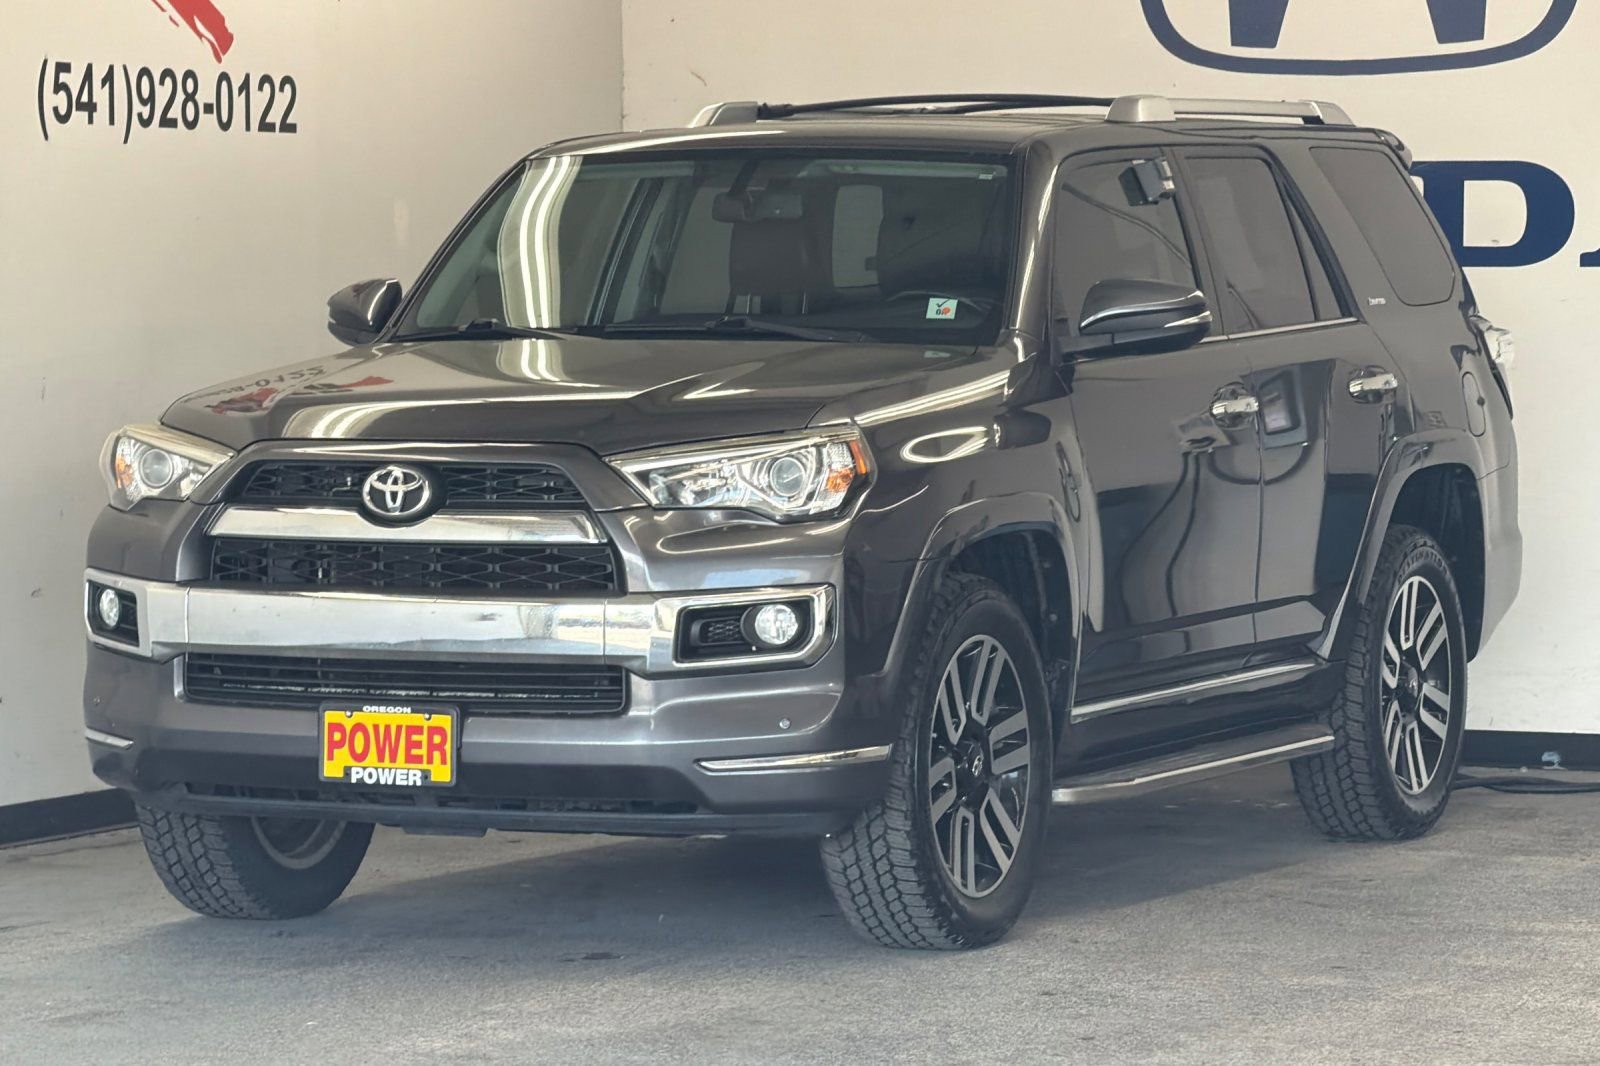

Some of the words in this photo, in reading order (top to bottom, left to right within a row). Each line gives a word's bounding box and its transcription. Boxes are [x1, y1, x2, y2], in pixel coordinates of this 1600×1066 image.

[38, 57, 298, 145] (541)928-0122
[362, 705, 412, 714] OREGON
[326, 722, 448, 766] POWER
[350, 766, 422, 786] POWER
